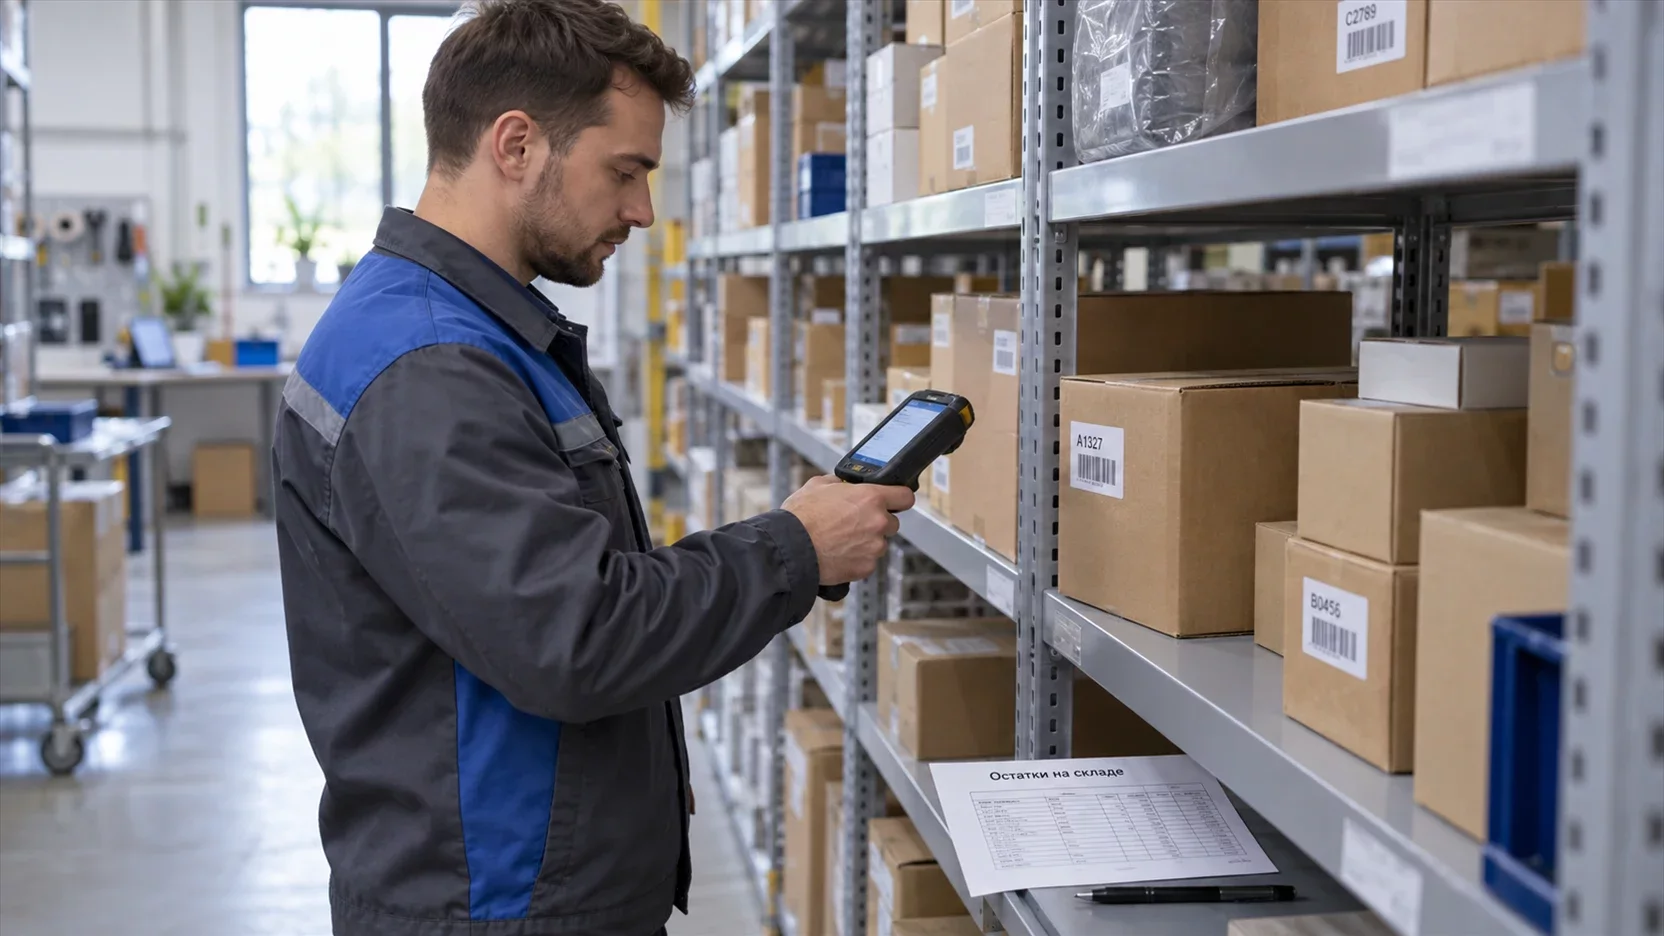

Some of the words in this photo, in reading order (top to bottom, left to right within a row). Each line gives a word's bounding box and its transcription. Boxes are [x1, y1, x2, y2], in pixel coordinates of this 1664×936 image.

[1345, 3, 1376, 26] C2789
[1076, 433, 1103, 450] A1327
[1311, 593, 1340, 618] B0456
[989, 771, 1049, 781] Остатки
[1052, 770, 1070, 778] на
[1073, 768, 1124, 778] складе
